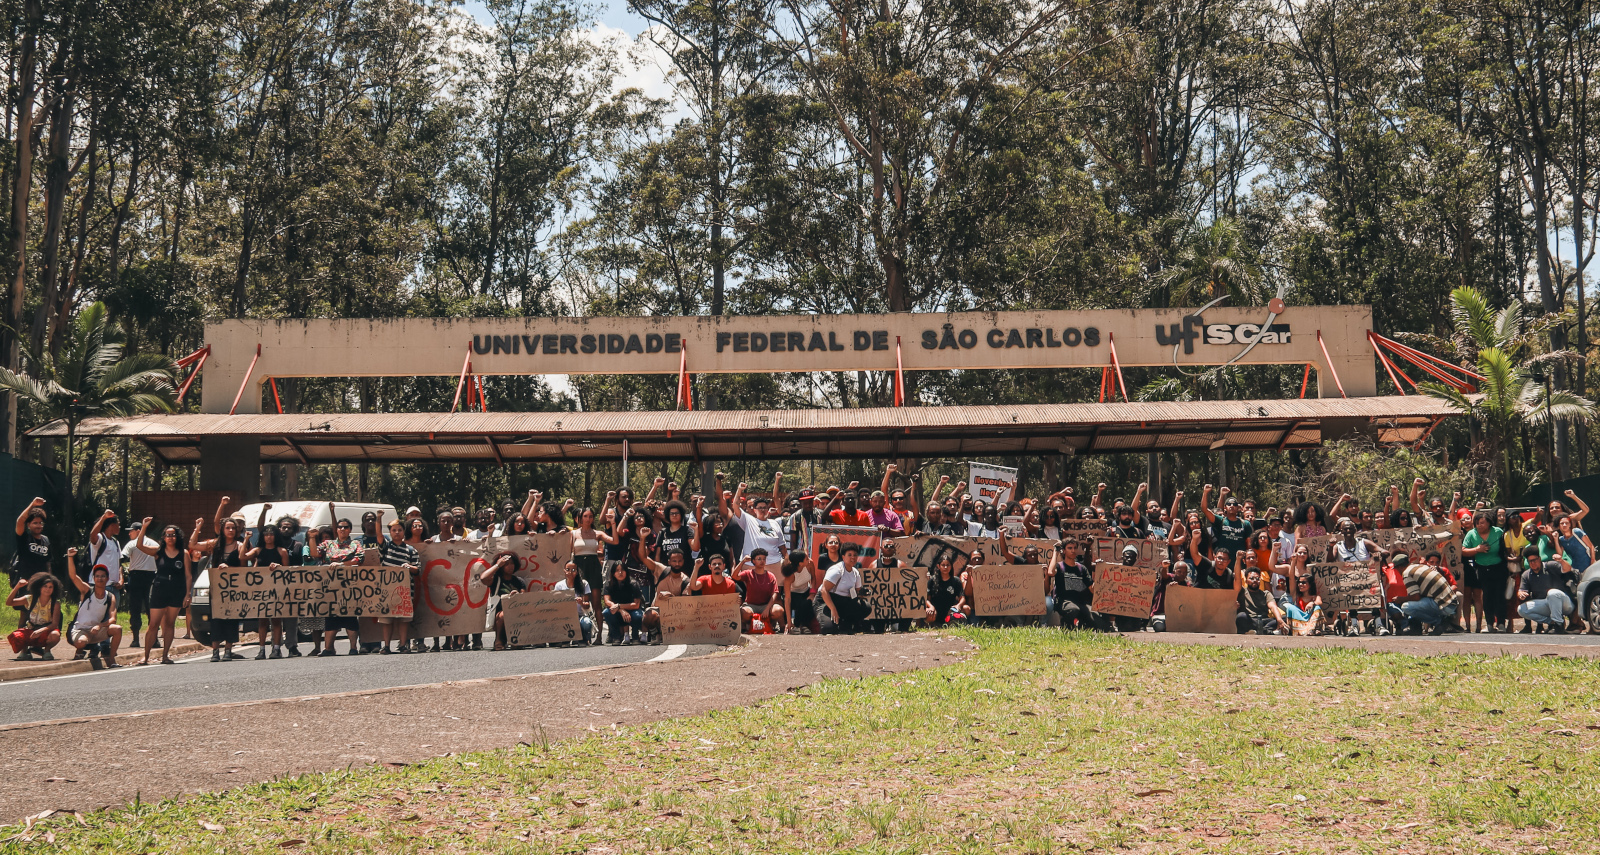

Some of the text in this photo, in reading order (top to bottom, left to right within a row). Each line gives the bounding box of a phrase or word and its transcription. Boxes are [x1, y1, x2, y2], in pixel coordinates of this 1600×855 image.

[473, 323, 1101, 355] UNIVERSIDADE FEDERAL DE SÃO CARLOS
[218, 568, 405, 590] SE OS PRETOS VELHOS TUDO
[283, 588, 291, 600] A
[294, 587, 325, 601] ELES
[329, 585, 374, 601] TUDO
[257, 601, 338, 617] PERTENCE
[910, 596, 927, 610] DA
